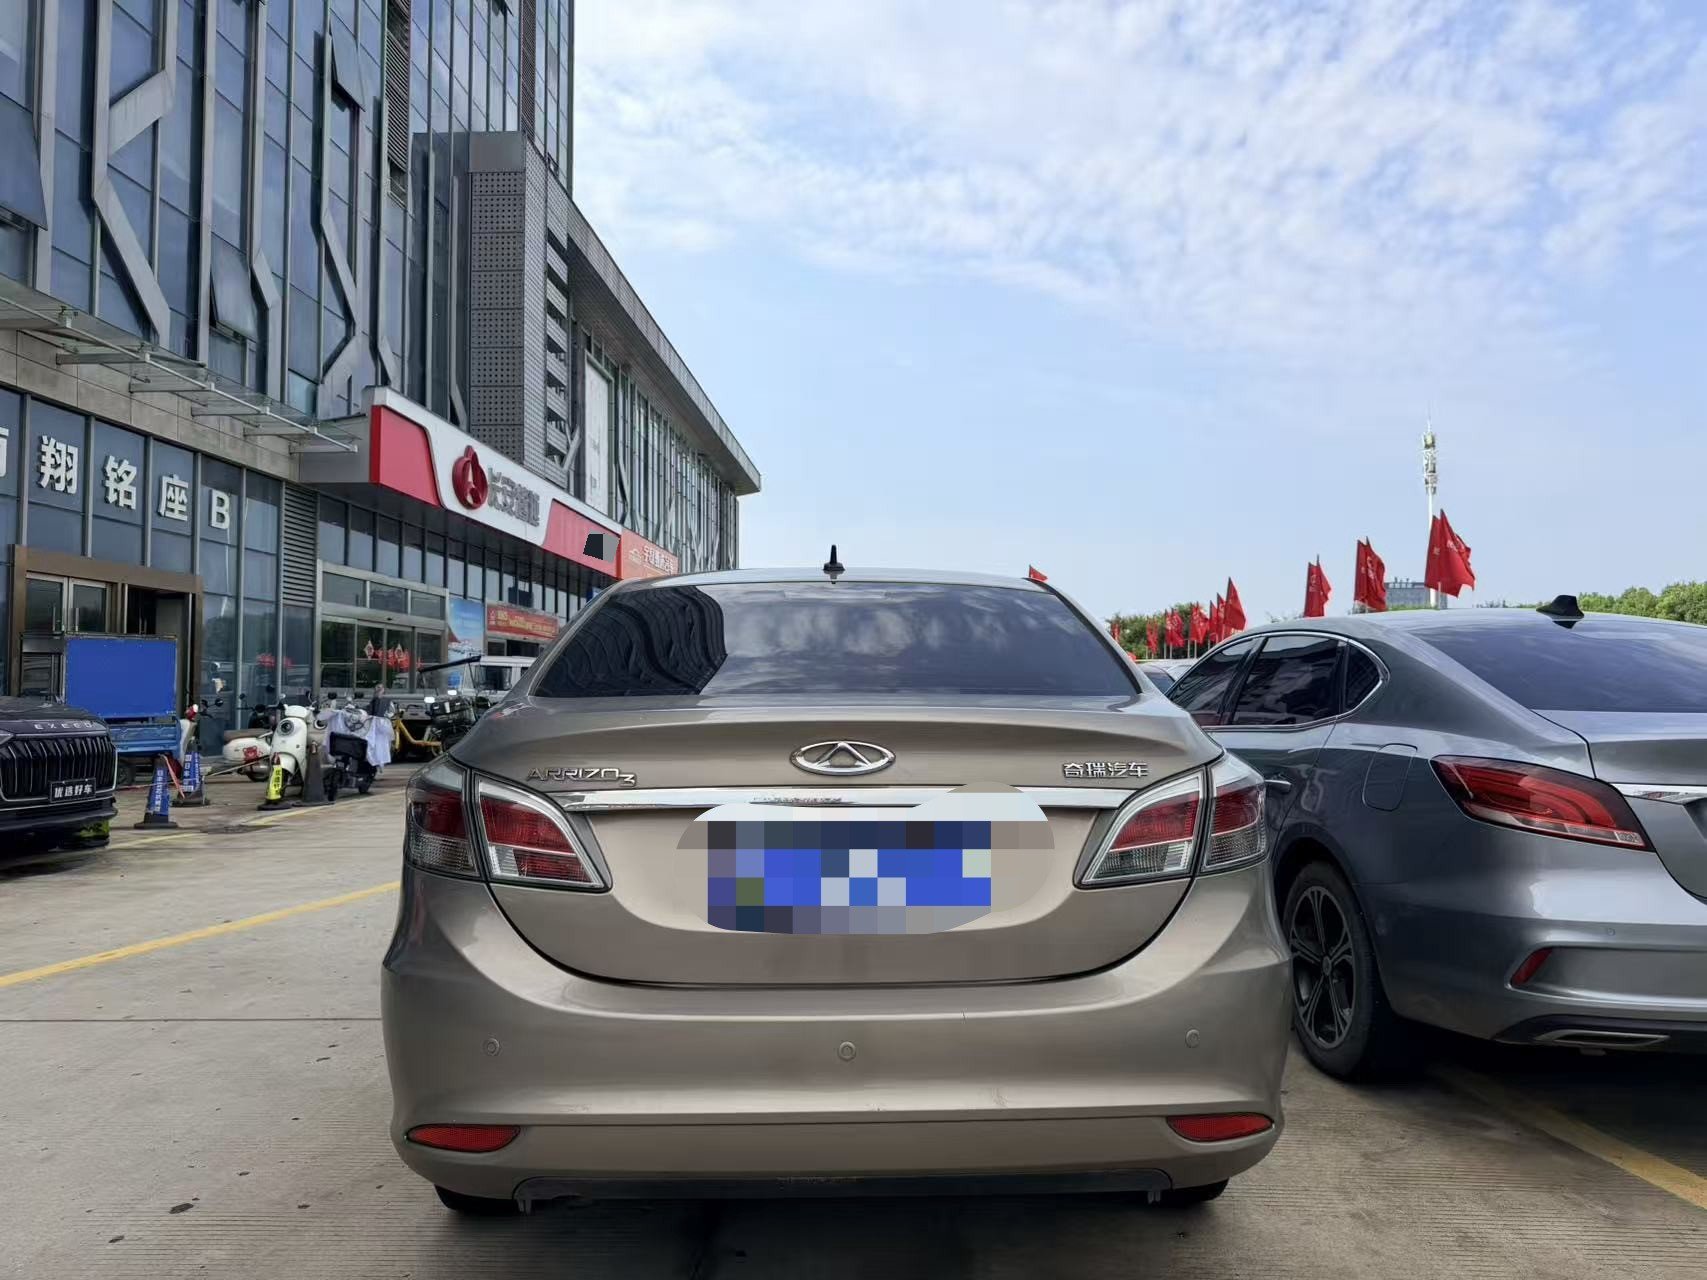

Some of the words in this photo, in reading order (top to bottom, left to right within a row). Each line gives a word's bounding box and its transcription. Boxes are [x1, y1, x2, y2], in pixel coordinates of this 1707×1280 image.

[1063, 762, 1148, 778] 奇瑞汽车
[54, 784, 93, 799] 优选好车
